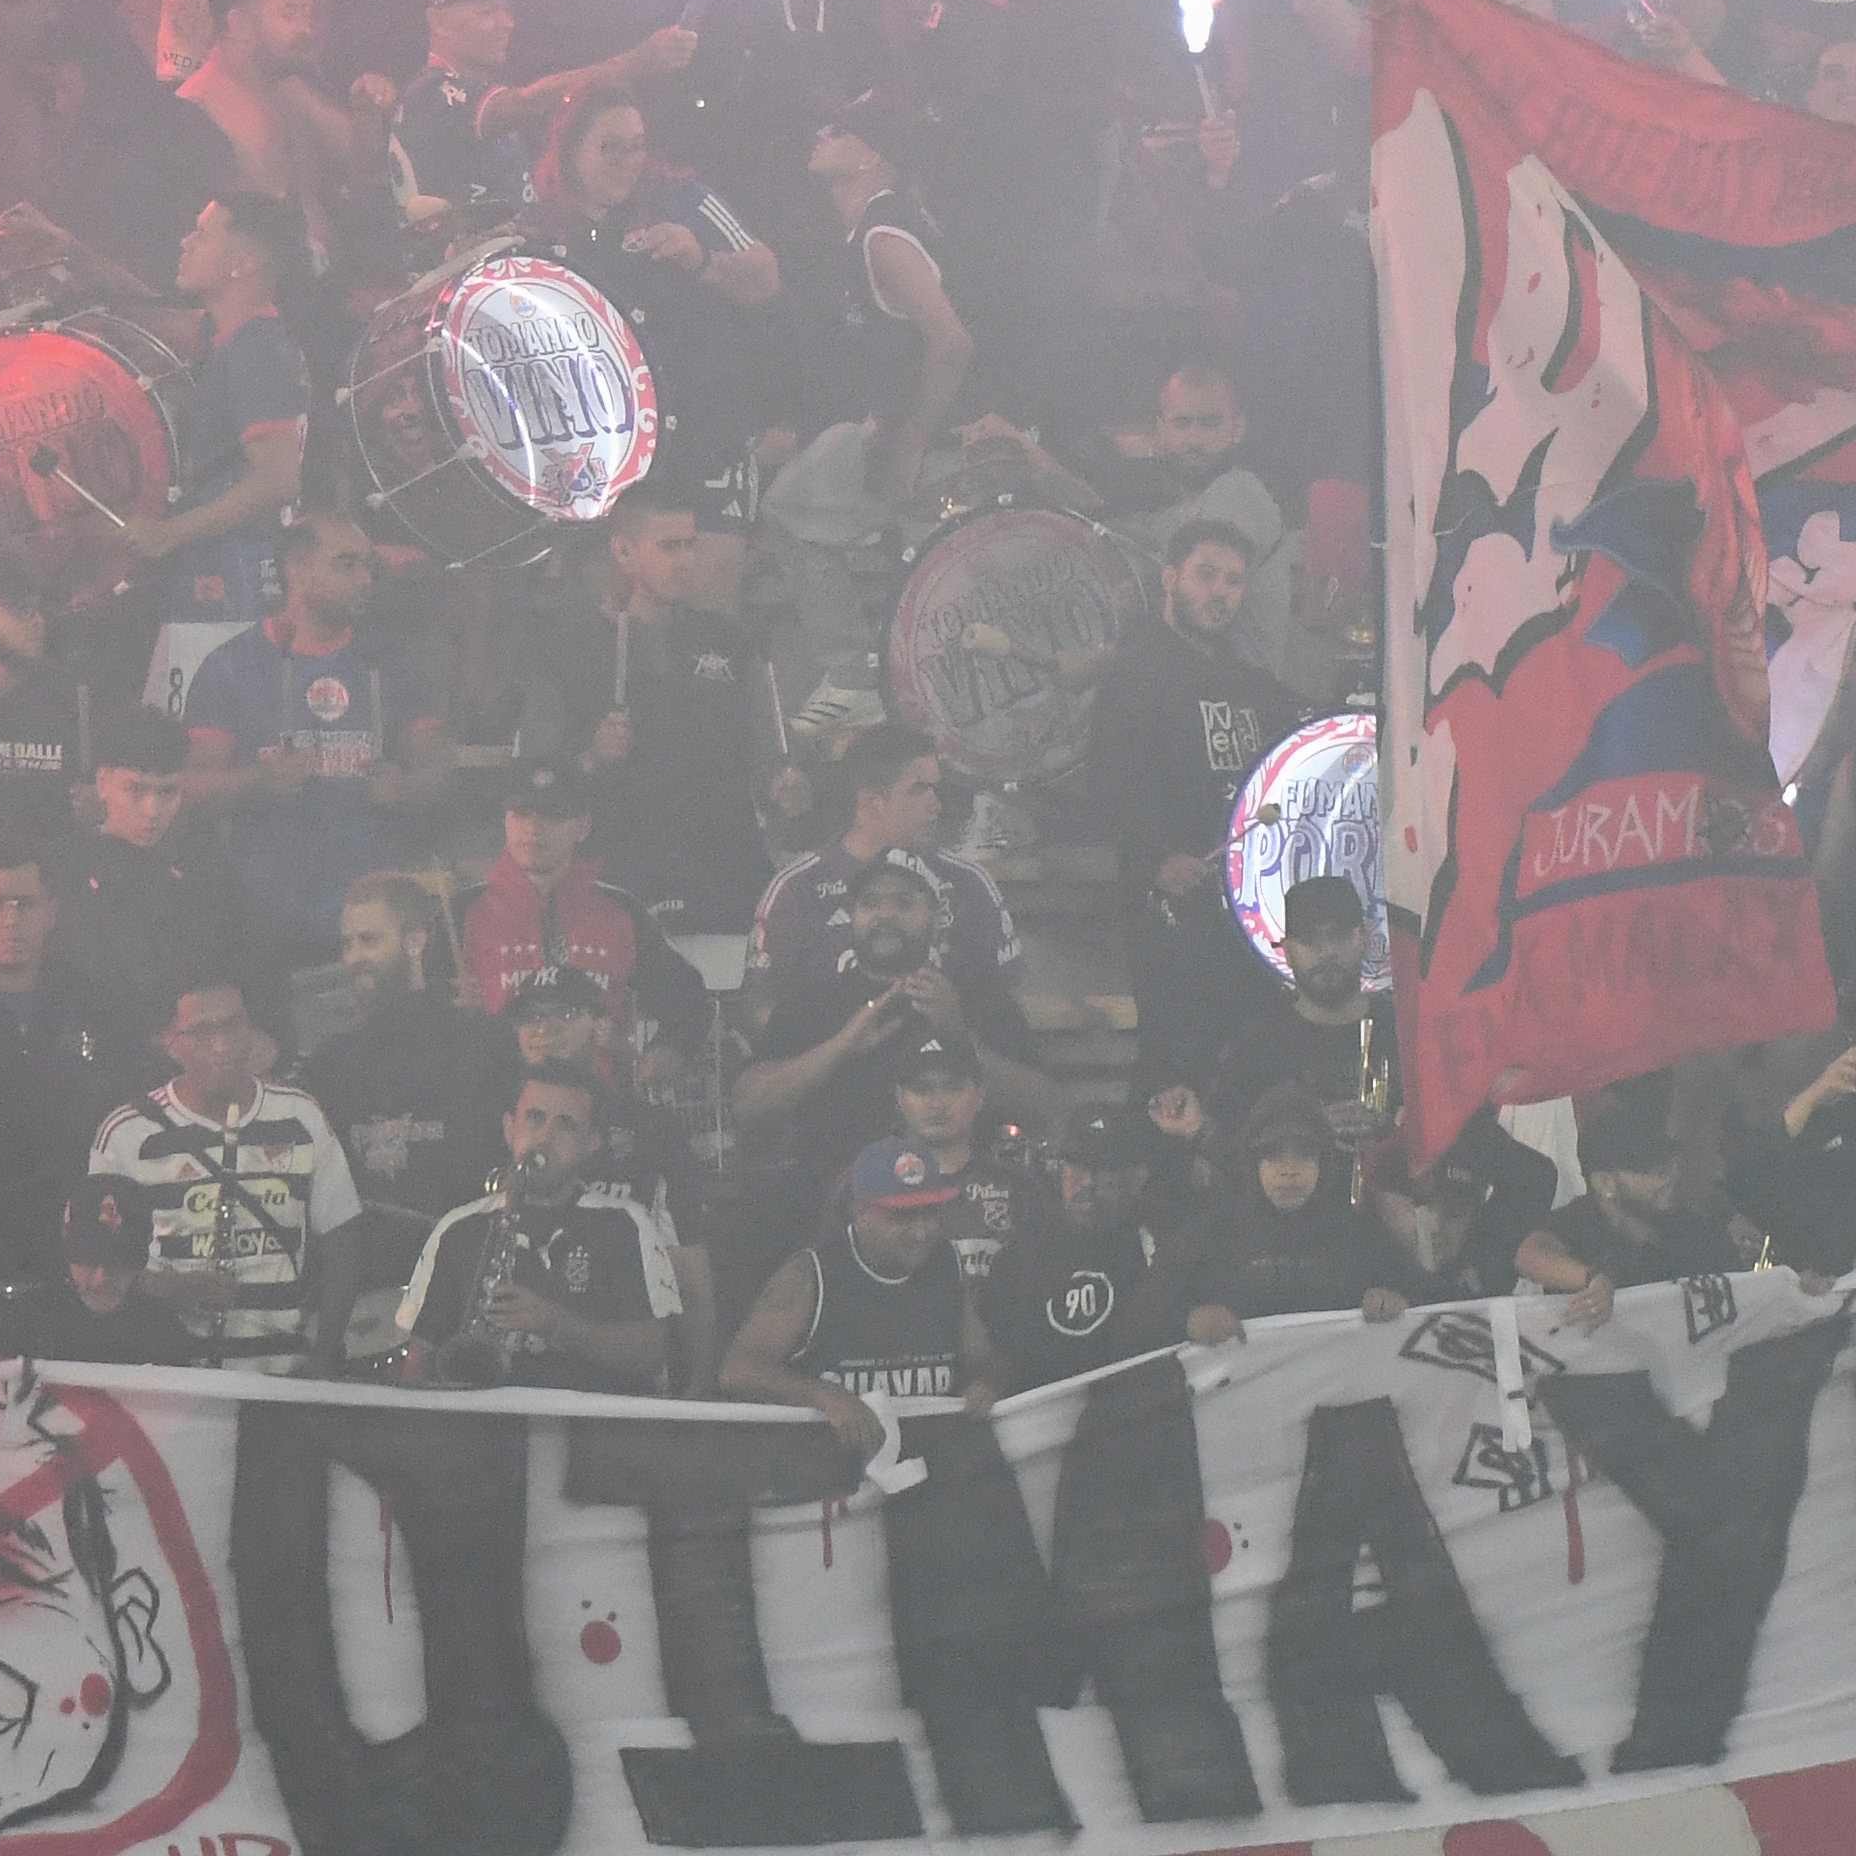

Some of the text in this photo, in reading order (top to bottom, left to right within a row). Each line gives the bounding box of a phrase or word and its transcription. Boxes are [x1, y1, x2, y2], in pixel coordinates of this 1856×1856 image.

[464, 309, 601, 365] TOMANDO
[462, 350, 637, 450] VINO
[1065, 1283, 1098, 1321] 90
